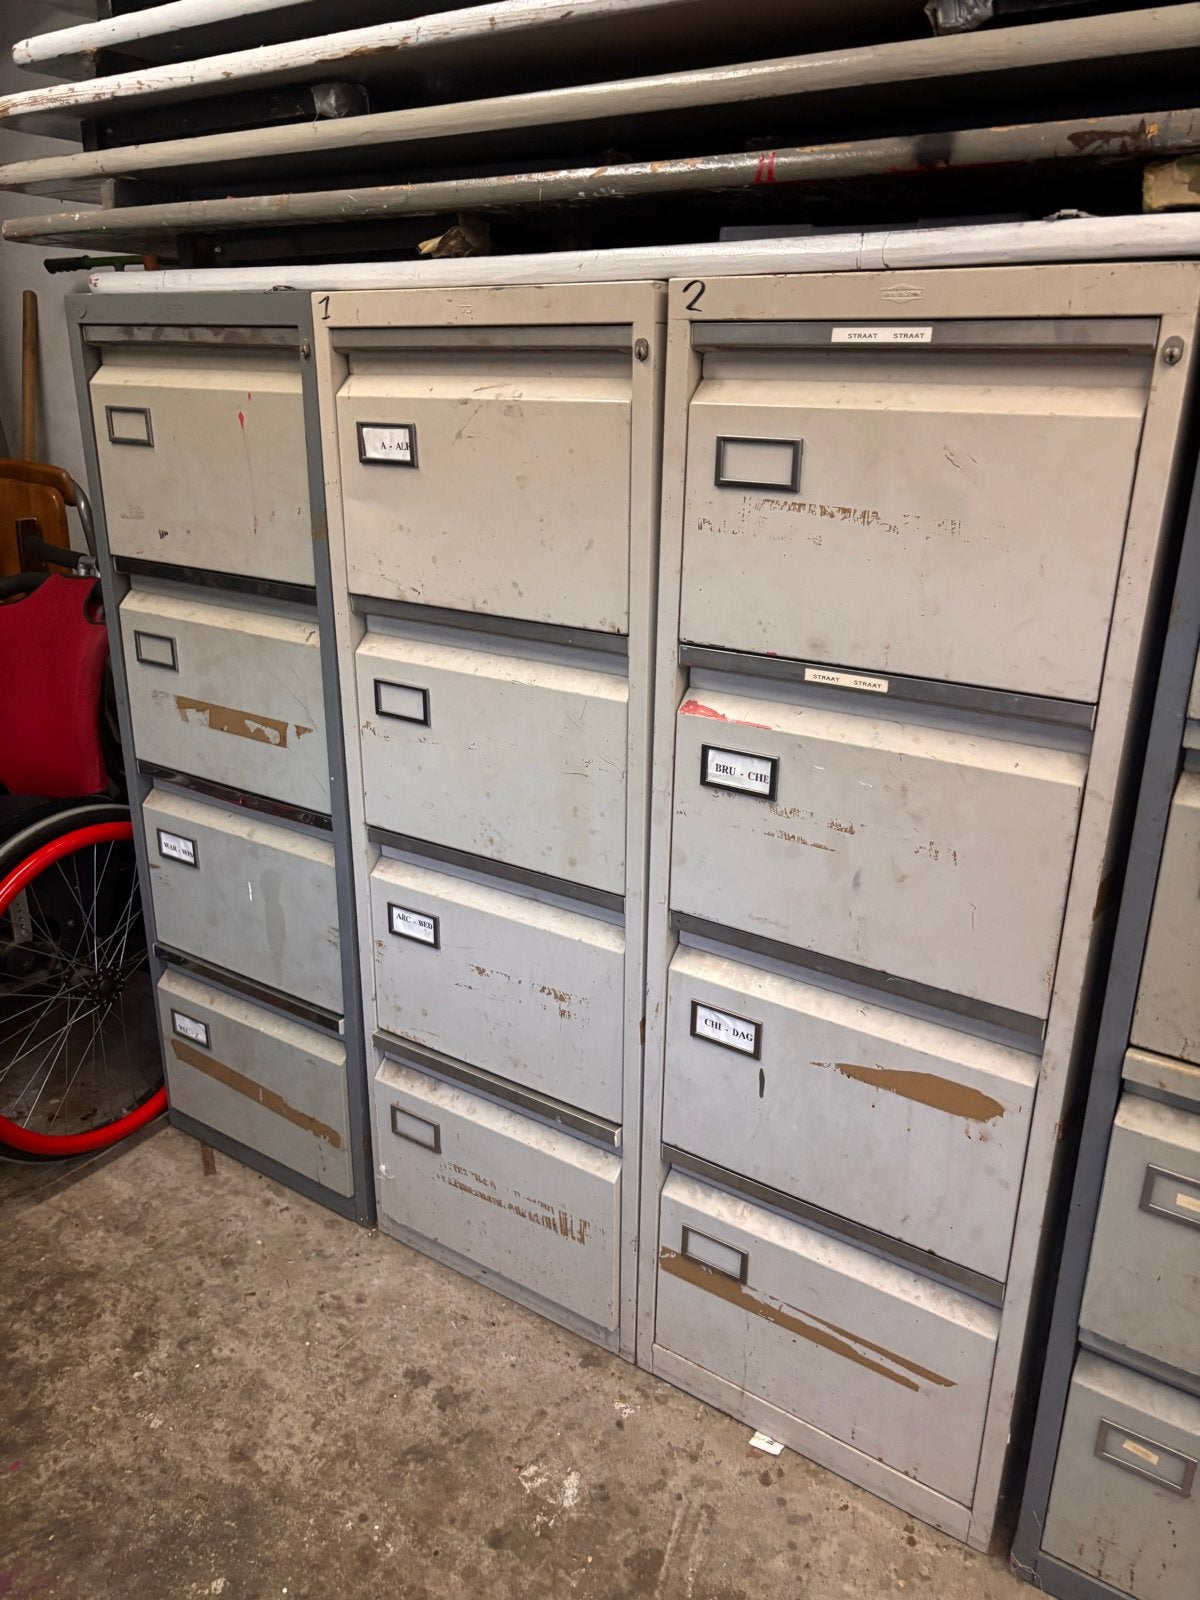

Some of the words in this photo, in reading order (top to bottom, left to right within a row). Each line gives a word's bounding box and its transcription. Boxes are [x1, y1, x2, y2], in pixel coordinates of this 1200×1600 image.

[682, 279, 706, 312] 2
[318, 295, 331, 320] 1
[380, 441, 387, 450] A
[812, 673, 840, 682] STRAAT
[853, 680, 883, 689] STRAAT
[715, 763, 736, 776] BRU
[747, 771, 769, 785] CHE
[396, 913, 411, 923] ARC
[704, 1018, 722, 1031] CHI
[732, 1027, 753, 1042] DAG
